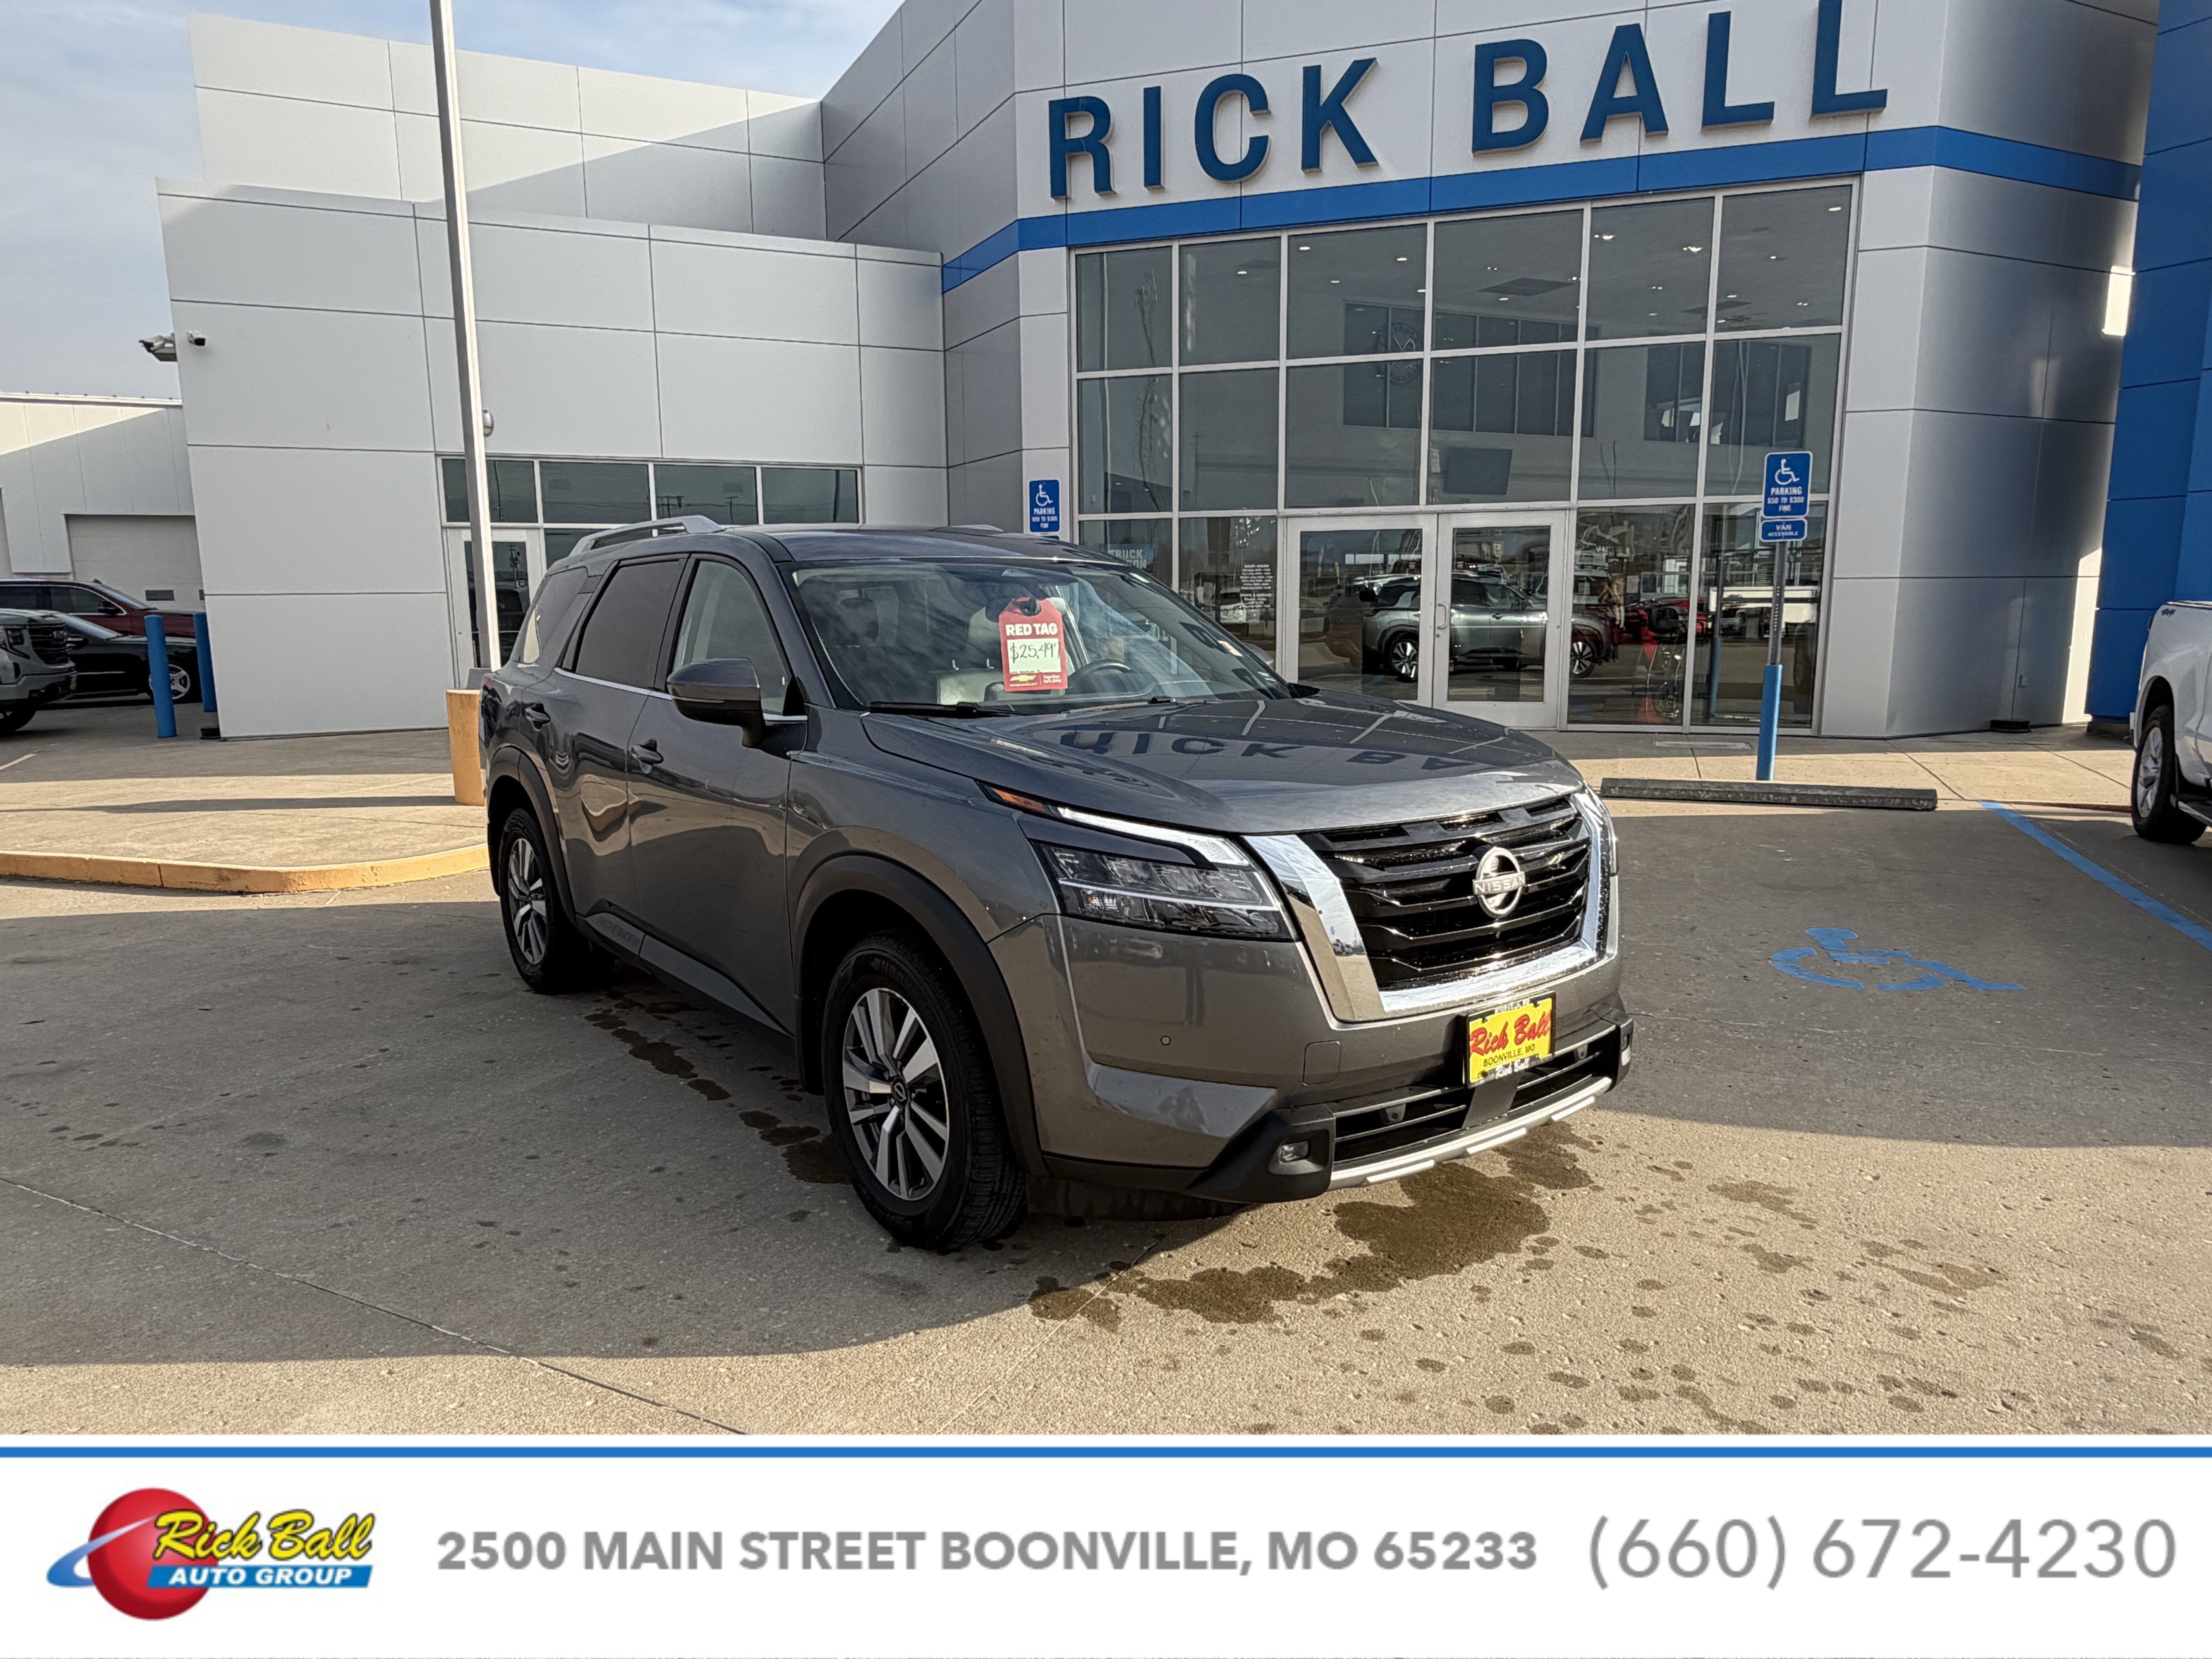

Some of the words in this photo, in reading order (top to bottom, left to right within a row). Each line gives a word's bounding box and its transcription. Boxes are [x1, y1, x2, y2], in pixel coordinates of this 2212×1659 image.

[1049, 57, 1378, 199] RICK
[1472, 0, 1887, 155] BALL
[1771, 486, 1802, 495] PARKING
[1006, 624, 1032, 635] RED
[1033, 623, 1058, 635] TAG
[1474, 875, 1525, 893] NISSAN
[1470, 1021, 1509, 1056] Rick
[1514, 1010, 1553, 1046] Ball
[1525, 1043, 1535, 1053] MO
